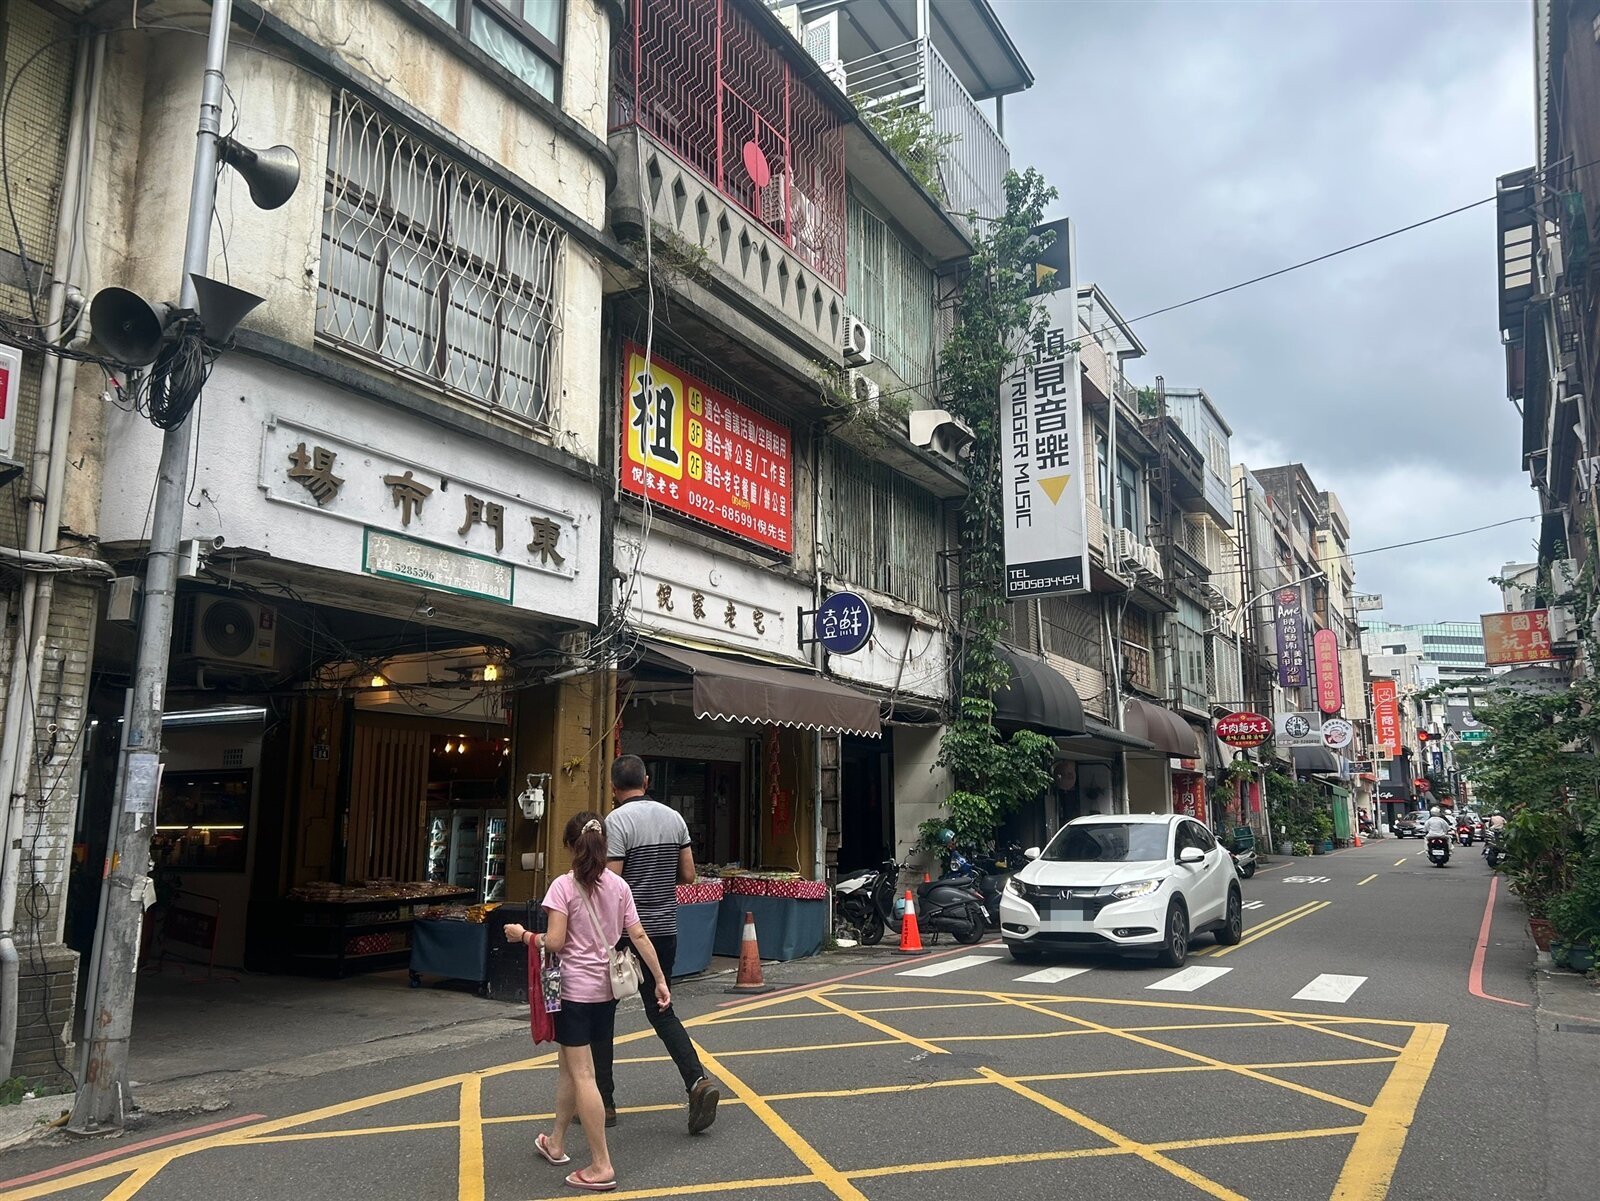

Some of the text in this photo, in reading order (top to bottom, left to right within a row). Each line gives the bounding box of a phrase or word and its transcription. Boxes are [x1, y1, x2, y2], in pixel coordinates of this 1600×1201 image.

[691, 391, 700, 411] 4F
[632, 374, 679, 465] 租
[691, 422, 700, 443] 3F
[1011, 367, 1032, 528] TRIGGER MUSIC
[691, 455, 700, 474] 2F
[631, 466, 680, 499] 倪家老宅
[395, 562, 435, 581] 5285596
[1010, 569, 1030, 580] TEL
[1010, 574, 1081, 592] 0905834454
[656, 583, 766, 635] 倪家老宅
[822, 605, 862, 640] 壹鮮
[1502, 631, 1549, 650] 玩具
[1219, 721, 1269, 735] 牛肉麵大王
